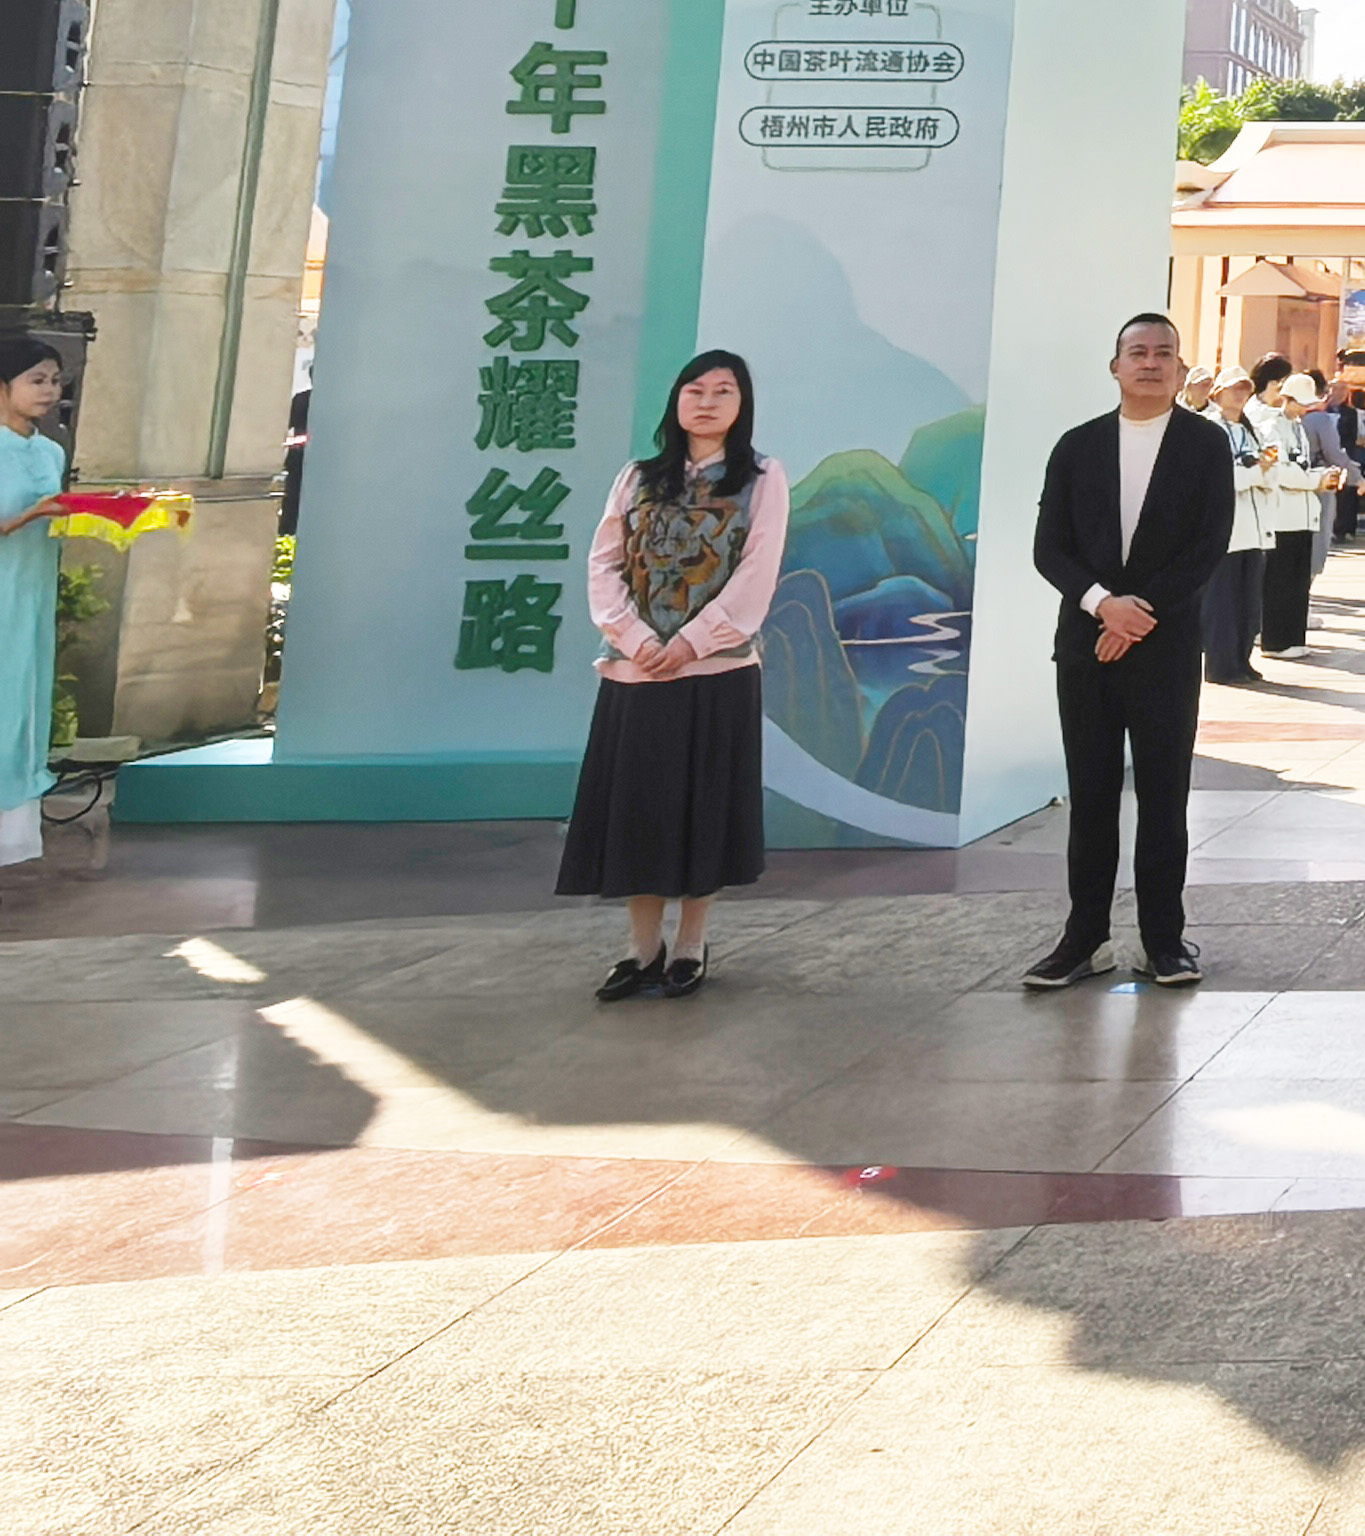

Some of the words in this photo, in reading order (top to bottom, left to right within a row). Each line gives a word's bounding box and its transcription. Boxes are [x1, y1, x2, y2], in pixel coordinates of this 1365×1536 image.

[752, 49, 957, 74] 中国茶叶流通协会
[760, 114, 940, 140] 梧州市人民政府
